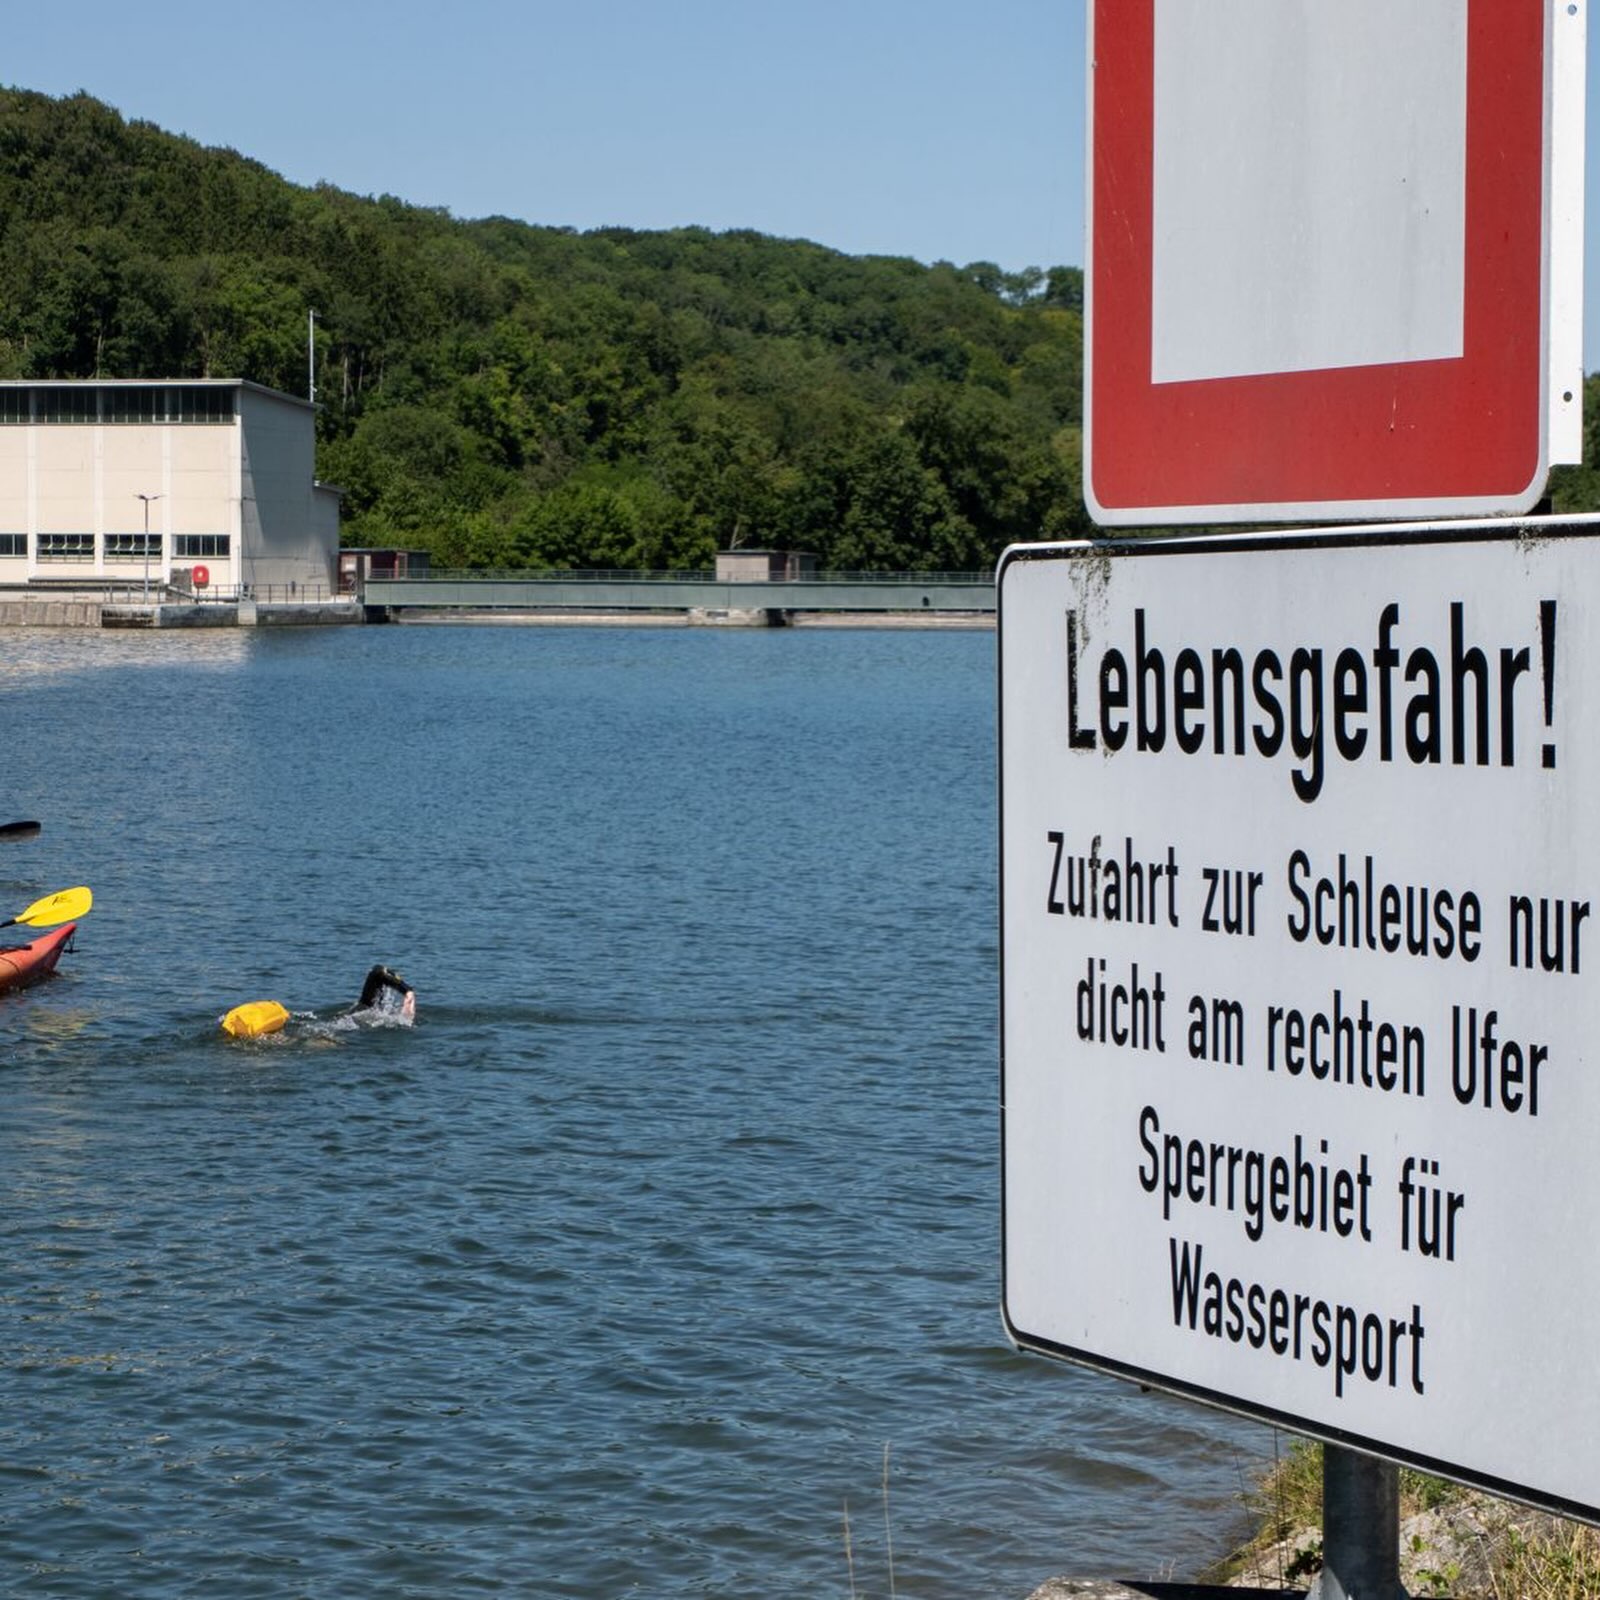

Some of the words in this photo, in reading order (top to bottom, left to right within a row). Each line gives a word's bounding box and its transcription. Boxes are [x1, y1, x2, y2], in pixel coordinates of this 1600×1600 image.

[1066, 600, 1557, 804] Lebensgefahr!
[1047, 831, 1179, 928] Zufahrt
[1202, 867, 1264, 937] zur
[1287, 849, 1481, 963] Schleuse
[1509, 895, 1590, 975] nur
[1076, 957, 1166, 1053] dicht
[1188, 995, 1244, 1066] am
[1267, 989, 1425, 1097] rechten
[1452, 1005, 1548, 1117] Ufer
[1138, 1105, 1372, 1243] Sperrgebiet
[1398, 1156, 1465, 1262] für
[1169, 1237, 1425, 1399] Wassersport
